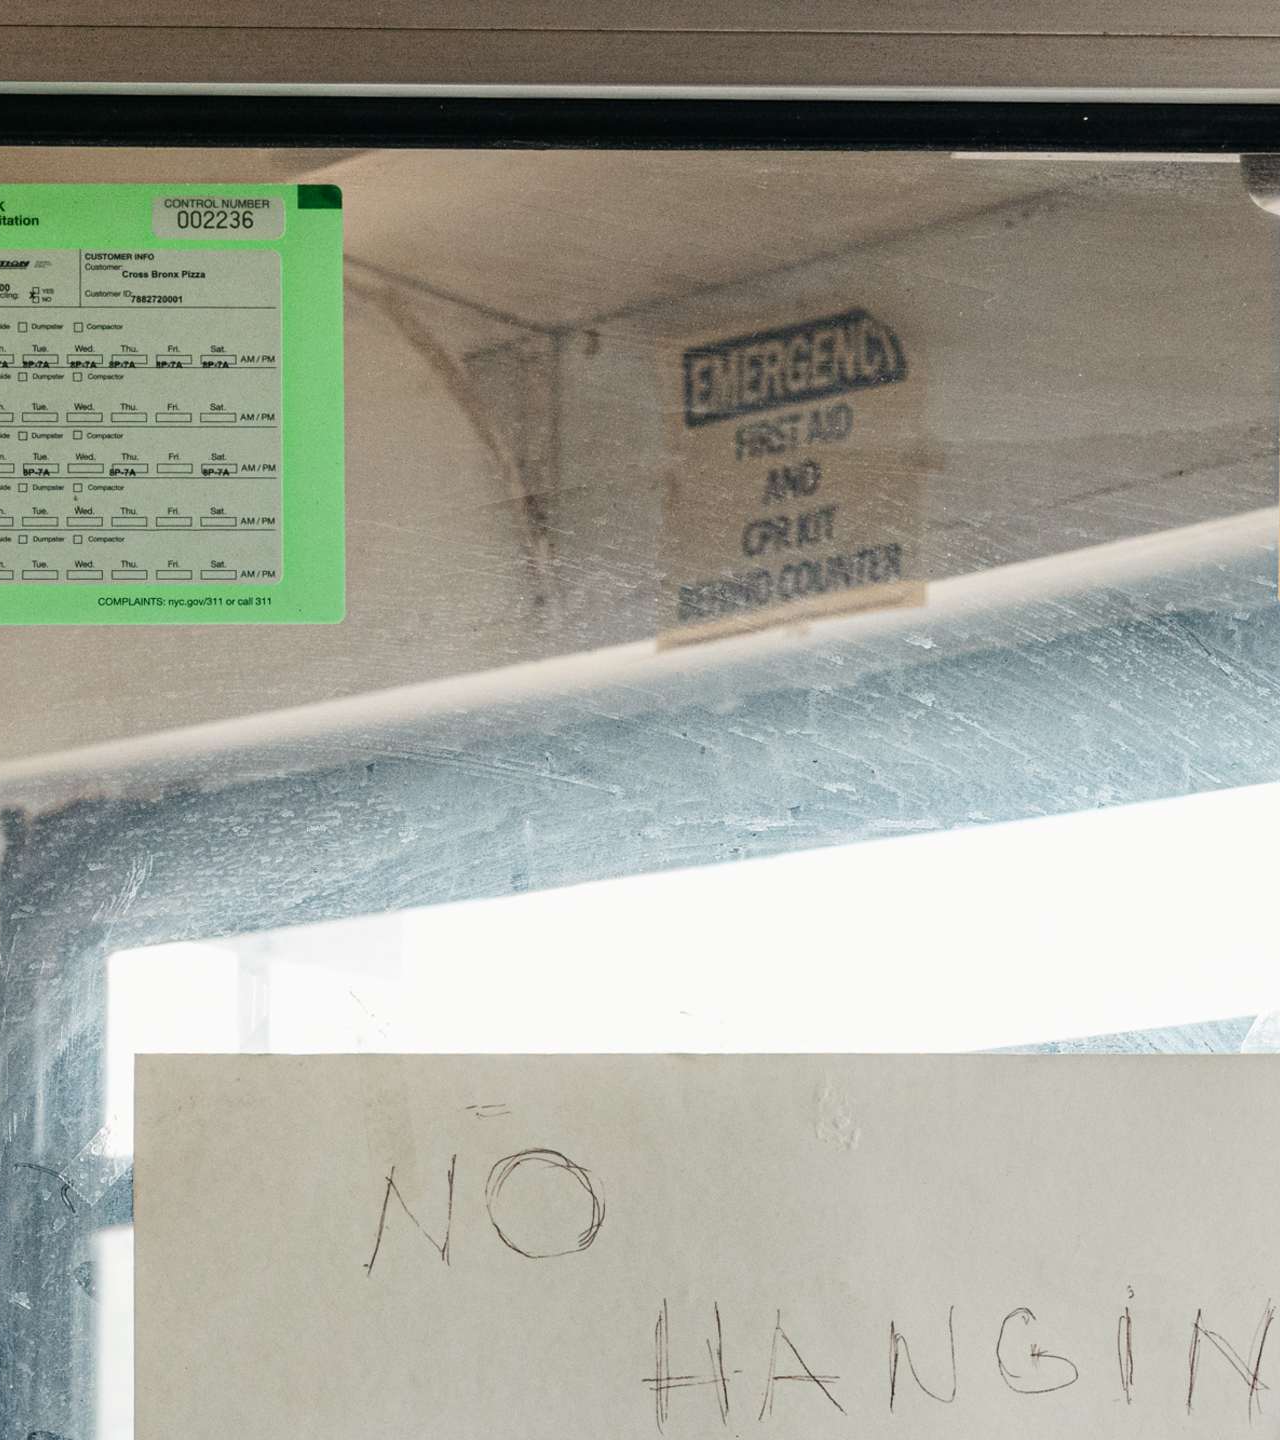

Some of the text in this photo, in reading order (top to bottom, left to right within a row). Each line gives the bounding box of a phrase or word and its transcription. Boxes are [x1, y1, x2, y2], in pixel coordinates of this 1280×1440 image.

[164, 199, 269, 208] CONTROL NUMBER
[177, 210, 254, 229] 002236
[85, 253, 154, 261] CUSTOMER INFO
[690, 320, 899, 416] EMERGENCY
[762, 457, 822, 504] AND
[98, 597, 166, 606] COMPLAINTS:
[168, 598, 223, 608] nyc.gov/311
[237, 597, 253, 606] call
[363, 1147, 607, 1276] NO
